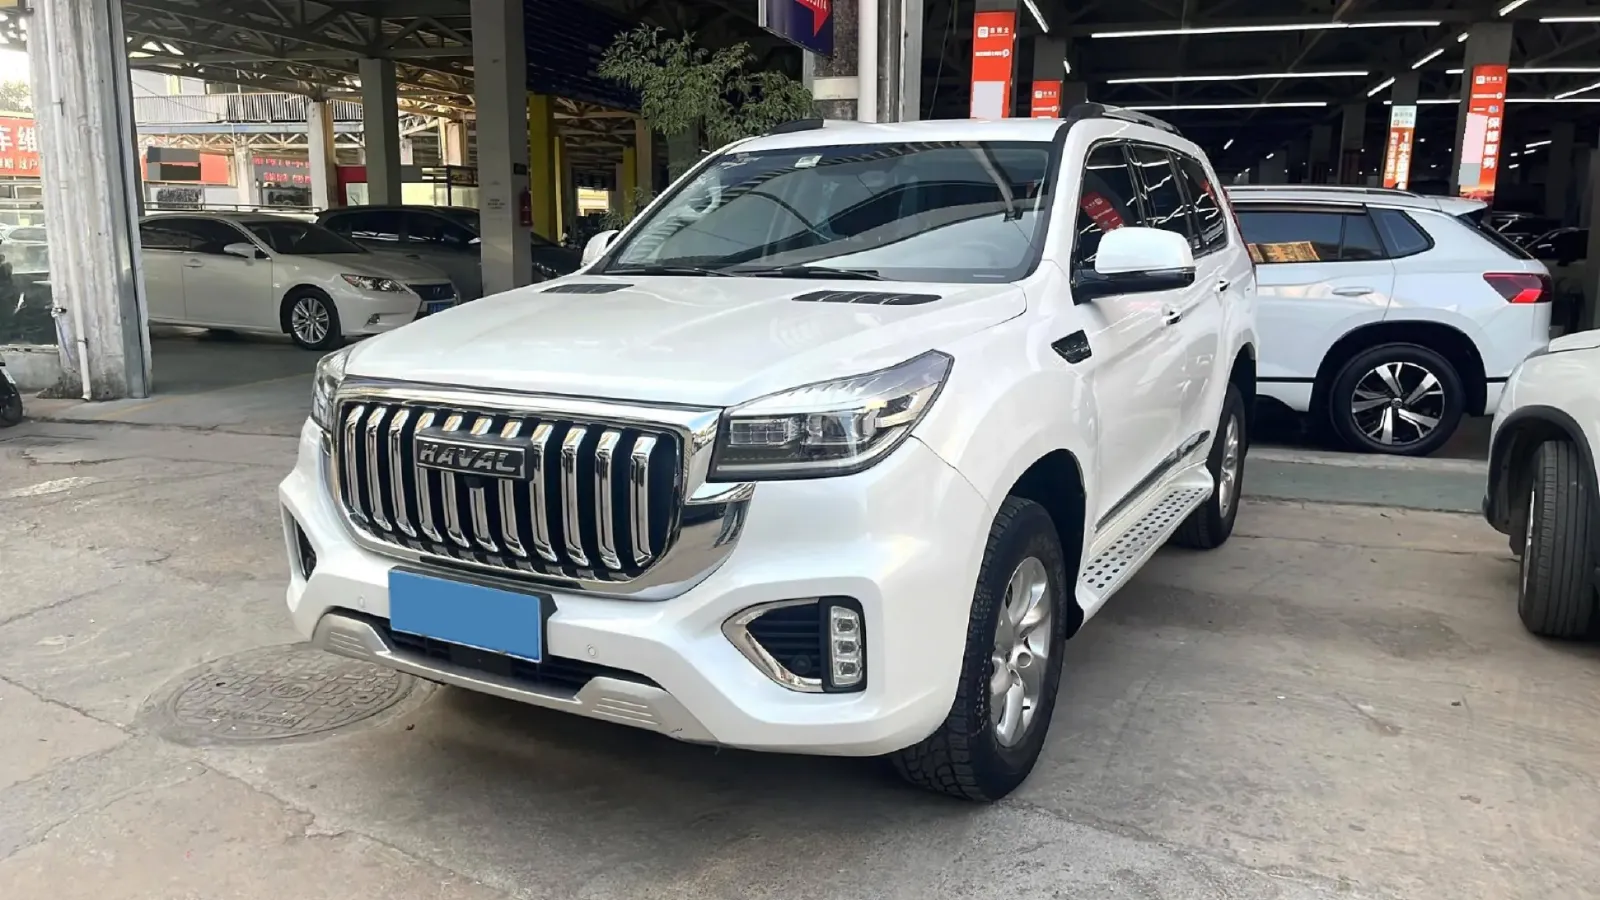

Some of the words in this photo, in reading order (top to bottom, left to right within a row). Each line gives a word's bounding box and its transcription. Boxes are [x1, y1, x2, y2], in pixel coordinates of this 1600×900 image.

[1482, 116, 1500, 169] 保修服务
[420, 443, 516, 473] HAVAL
